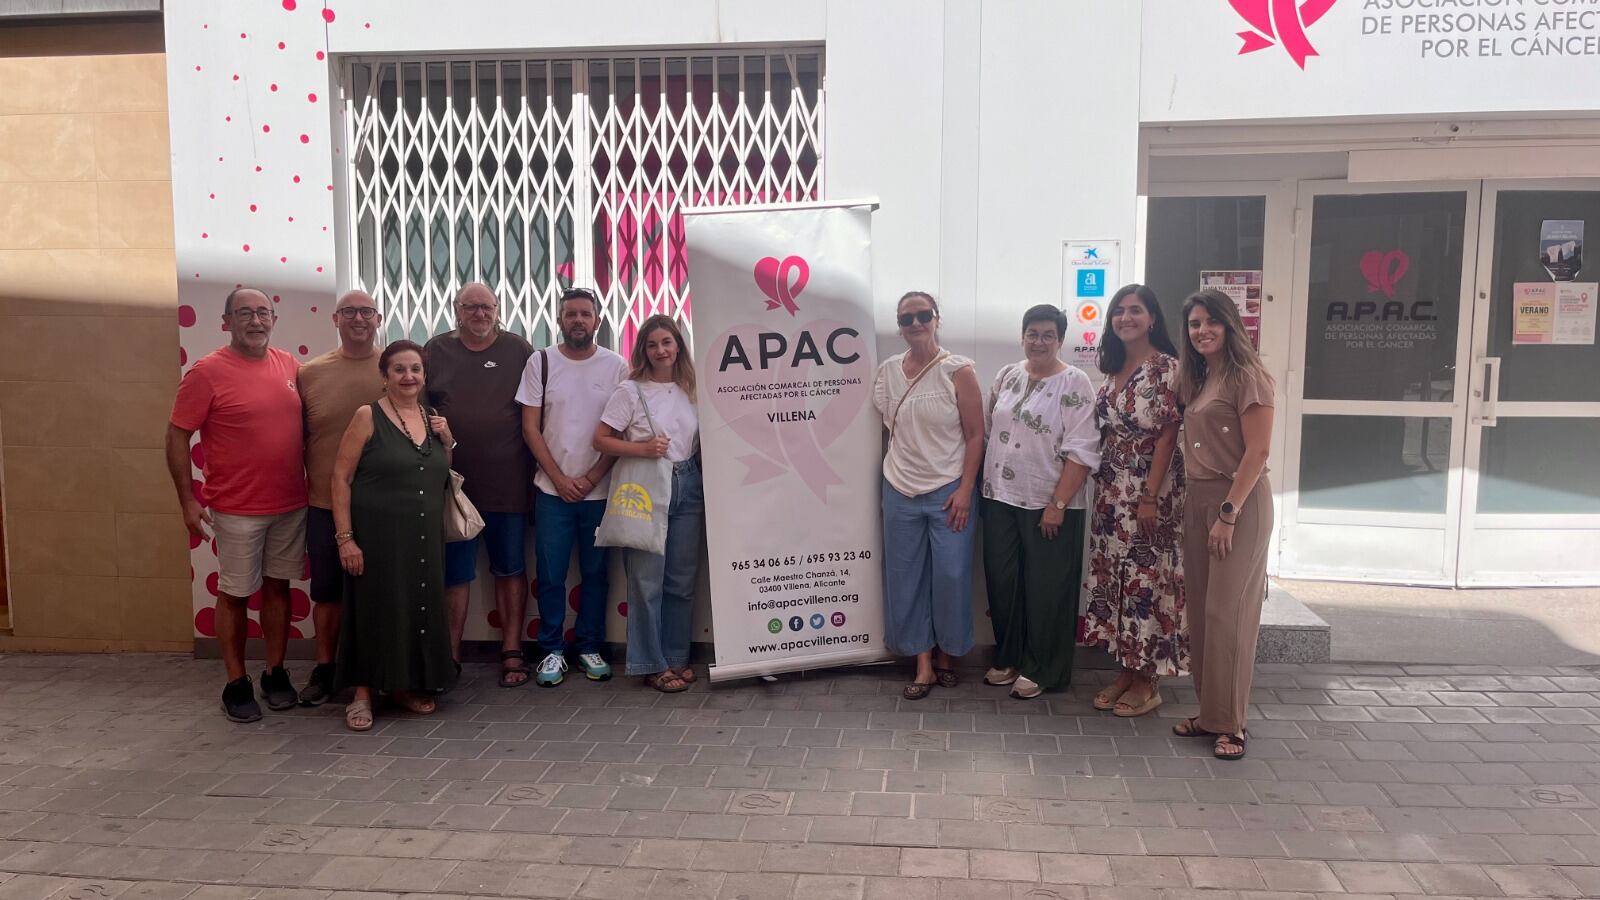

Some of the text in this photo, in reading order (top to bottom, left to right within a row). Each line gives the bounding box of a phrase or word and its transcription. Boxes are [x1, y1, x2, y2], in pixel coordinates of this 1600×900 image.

[1362, 11, 1600, 35] DE PERSONAS AFEC
[1421, 32, 1600, 58] POR EL CÁNCE
[1326, 301, 1438, 321] A.P.A.C.
[1520, 306, 1549, 314] VERANO
[1325, 332, 1437, 340] DE PERSONAS AFECTADAS
[719, 328, 861, 372] APAC
[1345, 341, 1364, 349] POR
[1366, 341, 1377, 349] EL
[717, 378, 862, 394] ASOCIACIÓN COMARCAL DE PERSONAS
[740, 392, 782, 401] AFECTADAS
[784, 391, 799, 399] POR
[809, 388, 841, 397] CÁNCER
[767, 410, 817, 423] VILLENA
[731, 560, 750, 571] 965
[753, 559, 766, 569] 34
[768, 558, 781, 568] 06
[783, 556, 796, 566] 65
[806, 553, 825, 564] 695
[828, 552, 841, 562] 93
[843, 551, 856, 561] 23
[858, 550, 872, 560] 40
[750, 576, 771, 585] Calle
[773, 573, 804, 582] Maestro
[840, 569, 851, 577] 14,
[759, 579, 846, 593] 03400 Villena, Alicante
[748, 593, 859, 612] info@apacvillena.org
[748, 633, 870, 654] www.apacvillena.org
